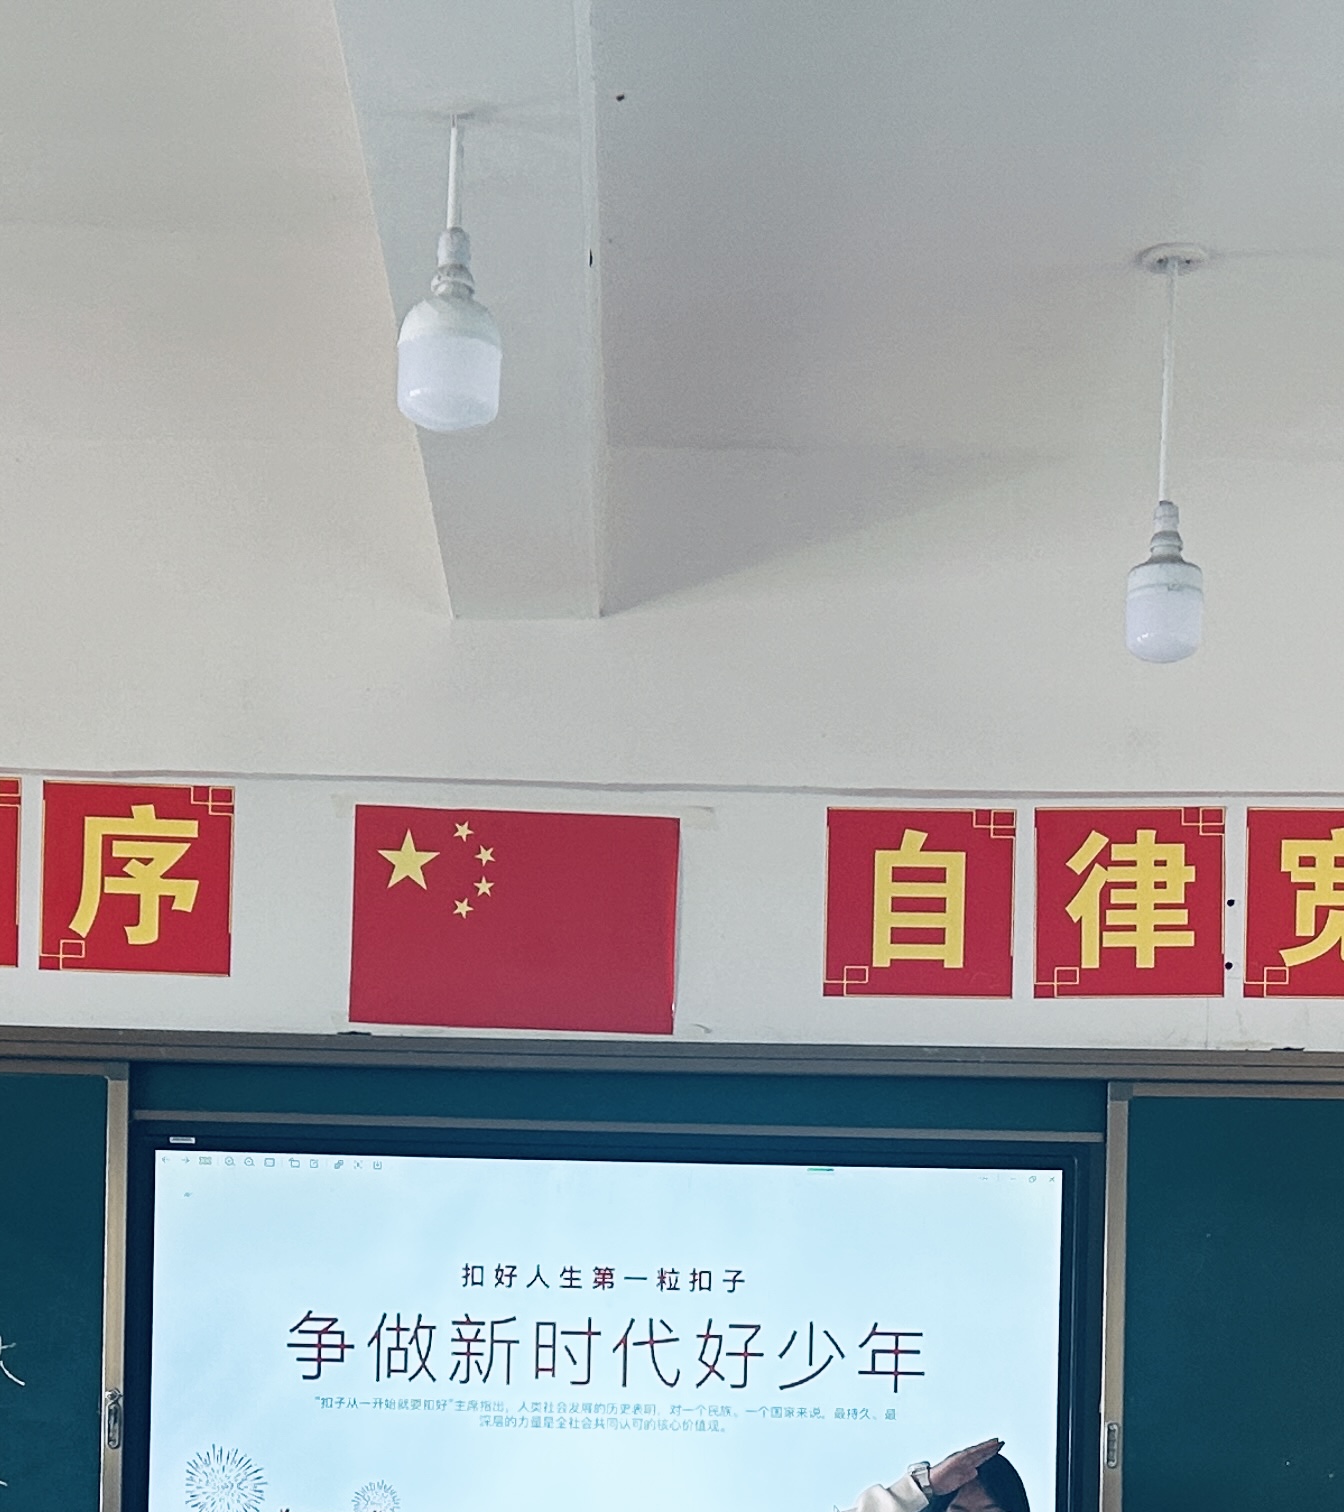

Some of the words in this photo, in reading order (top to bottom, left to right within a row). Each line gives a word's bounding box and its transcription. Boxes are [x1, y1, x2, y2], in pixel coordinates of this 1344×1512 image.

[460, 1263, 747, 1294] 扣好人生第一粒扣子
[286, 1309, 927, 1394] 争做新时代好少年
